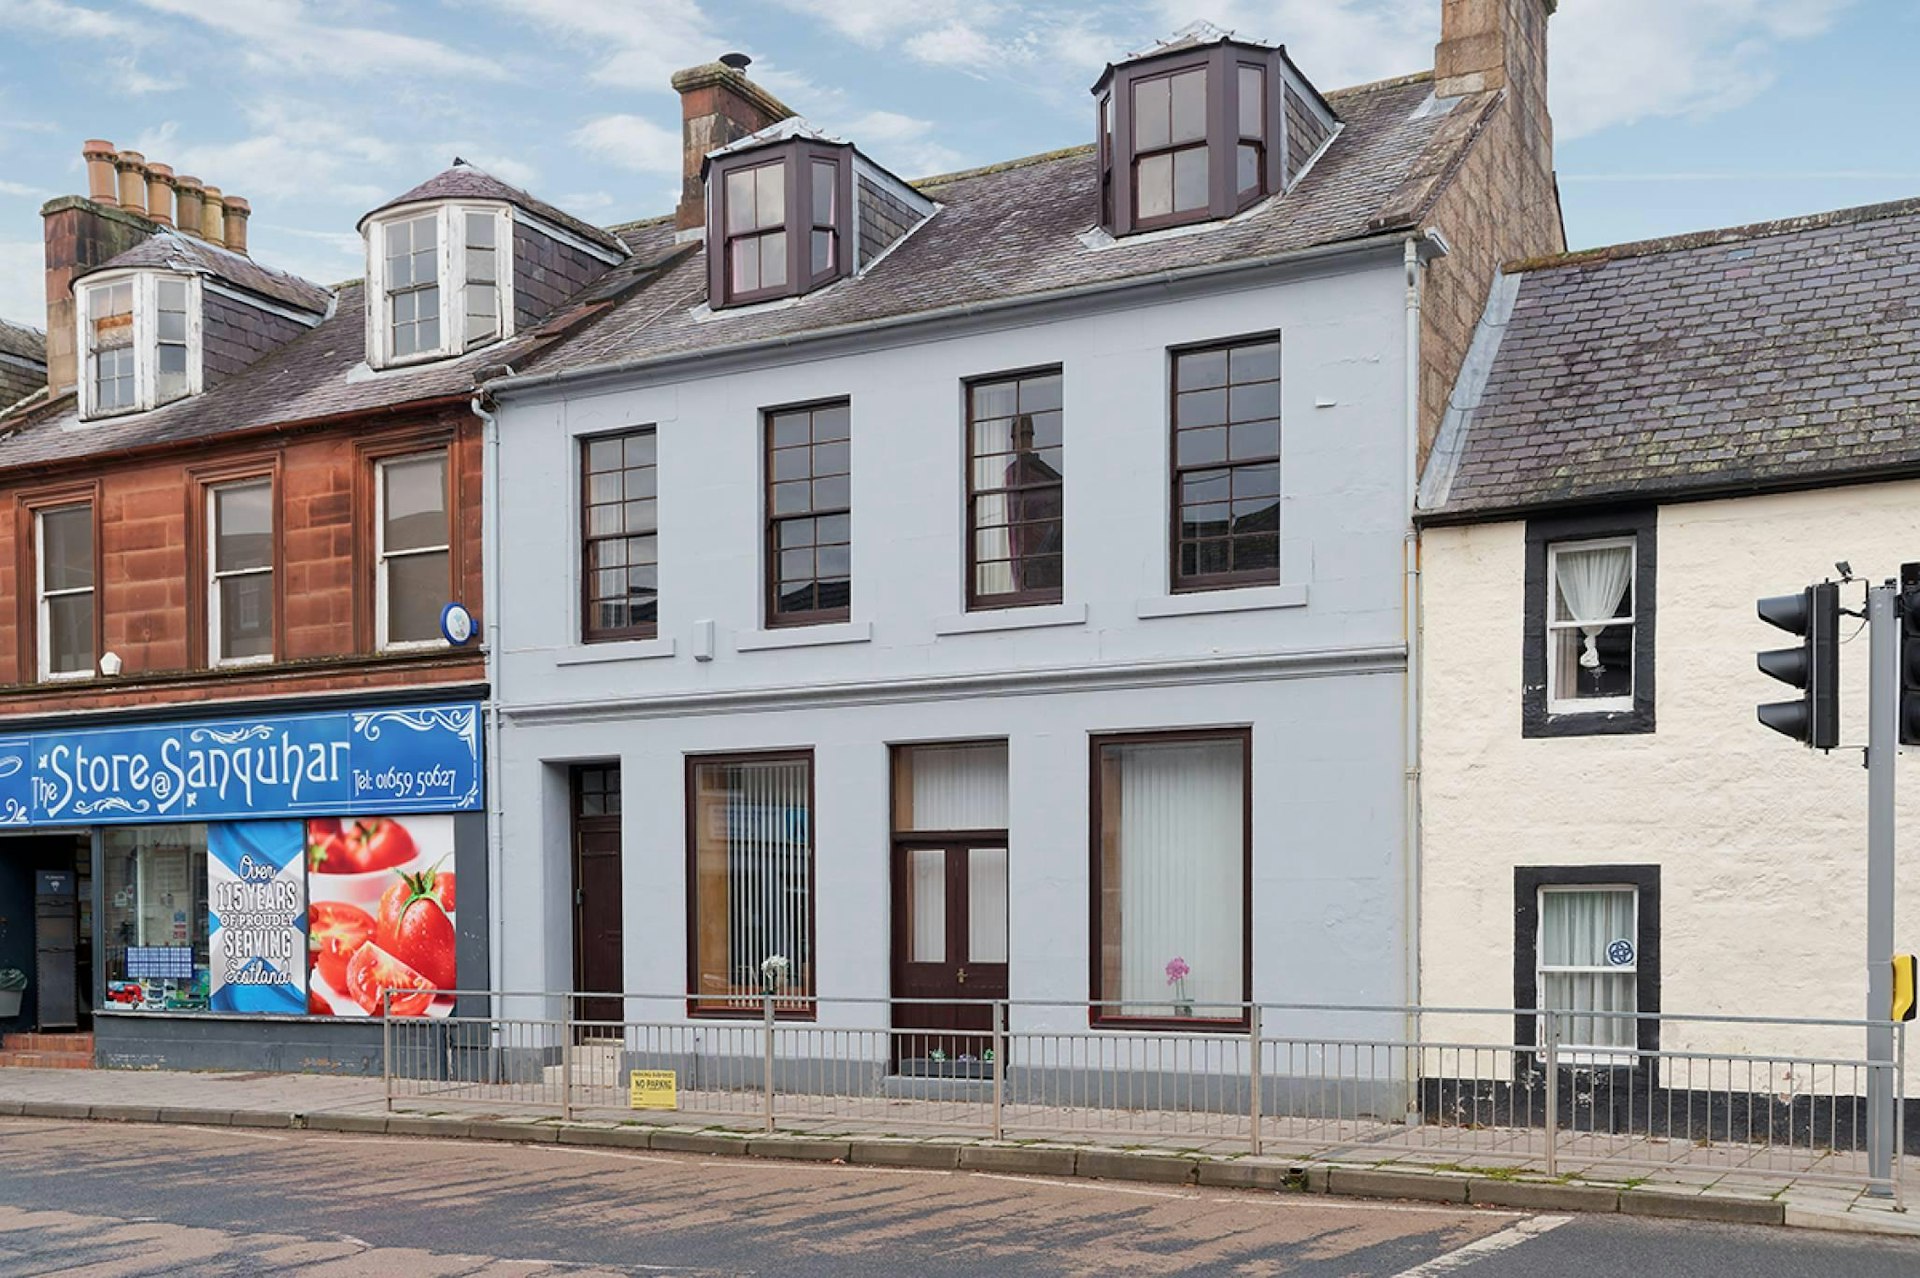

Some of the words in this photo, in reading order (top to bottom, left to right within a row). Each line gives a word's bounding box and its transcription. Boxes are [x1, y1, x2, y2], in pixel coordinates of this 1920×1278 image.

[49, 744, 150, 818] Store
[151, 771, 171, 799] @
[157, 731, 351, 814] Sanquhar
[352, 769, 374, 797] Tel:
[375, 766, 414, 797] 01659
[416, 763, 456, 796] 50627
[31, 776, 58, 810] The
[240, 855, 276, 880] Over
[217, 882, 244, 912] 115
[245, 881, 297, 911] YEARS
[220, 913, 238, 927] OF
[239, 912, 296, 926] PROUDLY
[224, 929, 292, 958] SERVING
[225, 959, 291, 985] Scotland
[635, 1079, 645, 1088] NO
